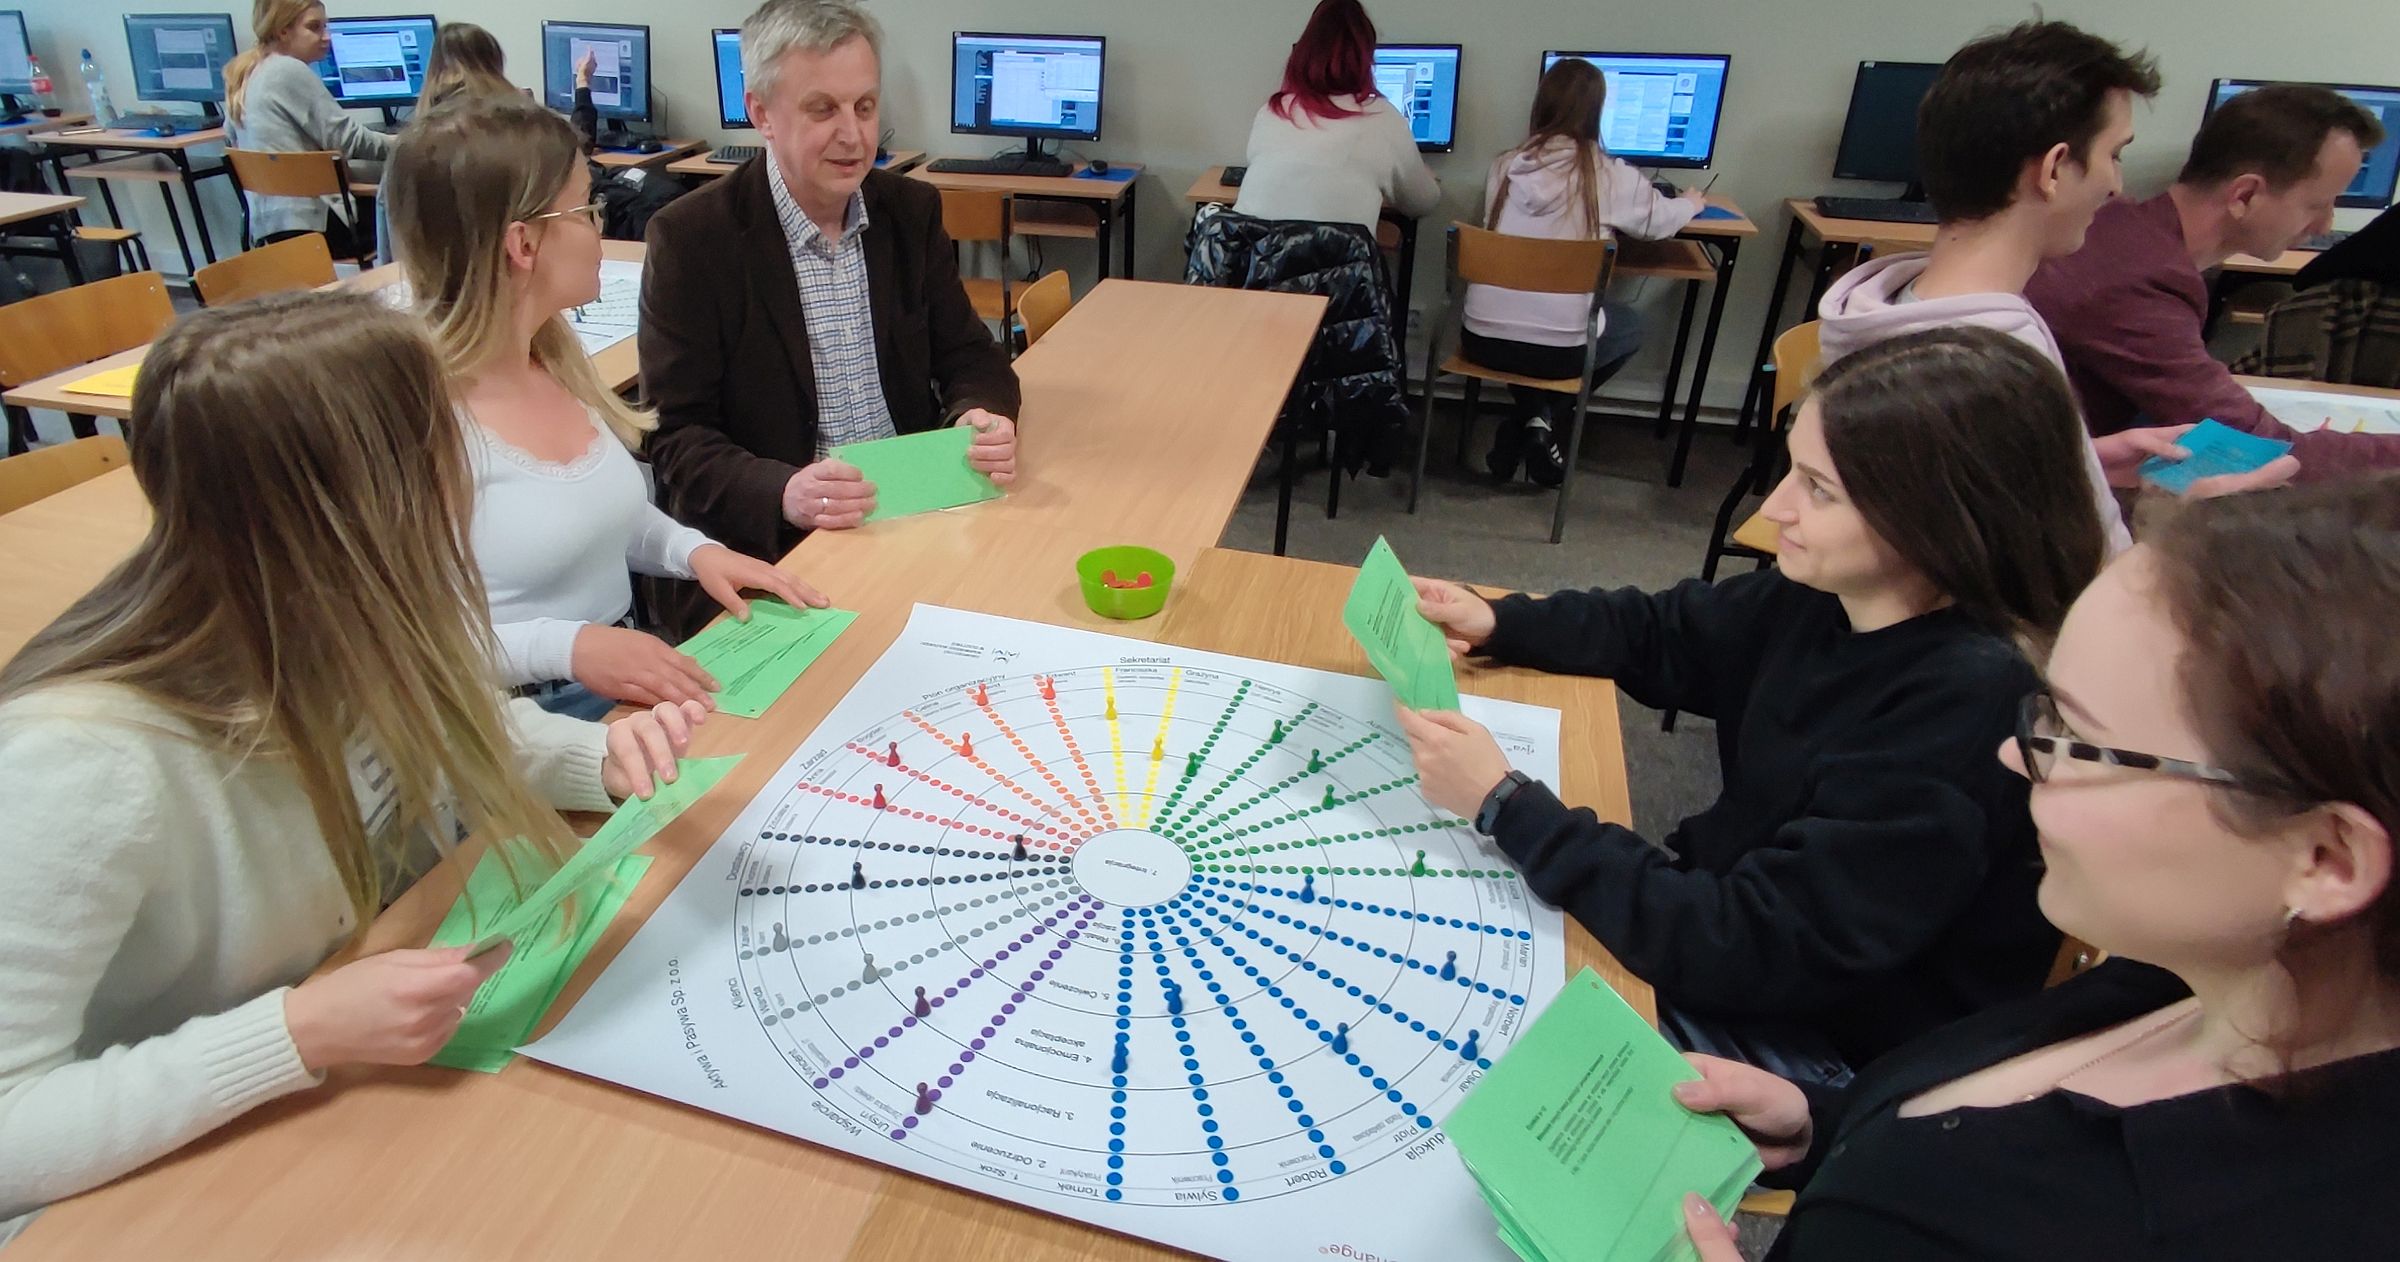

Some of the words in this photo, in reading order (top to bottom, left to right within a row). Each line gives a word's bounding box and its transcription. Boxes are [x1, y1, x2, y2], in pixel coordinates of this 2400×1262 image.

[1119, 656, 1171, 665] Sekretariat
[725, 977, 745, 1010] Klienci
[677, 1007, 701, 1050] Pasywa
[1498, 1006, 1520, 1037] Norbert
[1014, 1037, 1079, 1062] Emocjonalna
[1030, 1028, 1086, 1048] akceptacja
[697, 1054, 728, 1089] Aktywa
[788, 1048, 816, 1079] Vincent
[1458, 1069, 1483, 1093] Oskar
[986, 1089, 1061, 1119] Racjonalizacja
[1065, 1111, 1074, 1120] 3.
[812, 1100, 862, 1136] Wsparcie
[860, 1110, 890, 1132] Ursyn
[1393, 1124, 1419, 1144] Piotr
[1405, 1131, 1446, 1161] dukcja
[970, 1141, 1033, 1165] Odrzucenie
[980, 1164, 1007, 1177] Szok
[1285, 1167, 1328, 1187] Robert
[1057, 1182, 1099, 1198] Tomek
[1174, 1190, 1218, 1202] Sylwia
